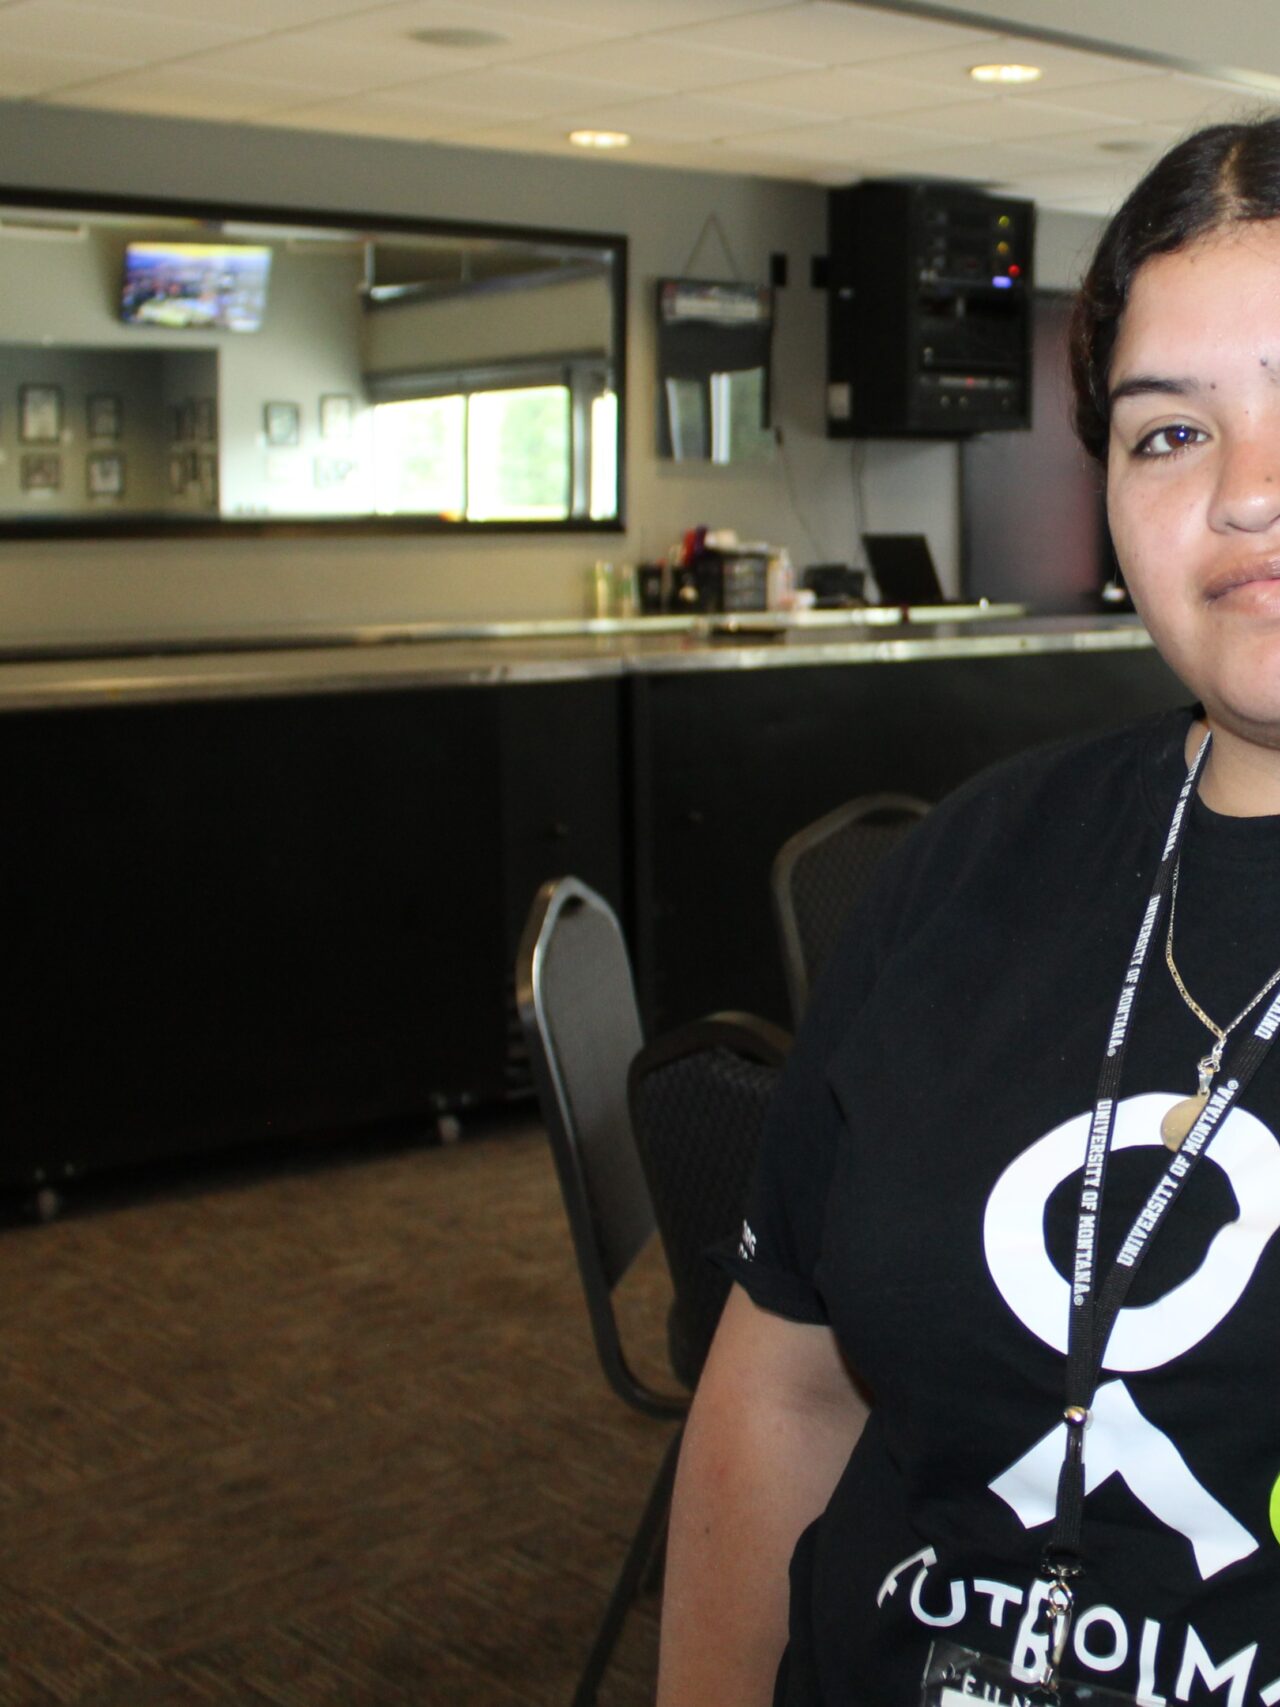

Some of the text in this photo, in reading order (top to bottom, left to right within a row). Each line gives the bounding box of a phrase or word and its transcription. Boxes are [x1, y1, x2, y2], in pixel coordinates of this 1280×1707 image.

[1130, 894, 1161, 966] UNIVERSITY
[1126, 966, 1141, 984] OF
[1083, 1098, 1113, 1188] UNIVERSITY
[1081, 1189, 1099, 1211] OF
[1116, 1174, 1179, 1267] UNIVERSITY
[1169, 1154, 1191, 1177] OF
